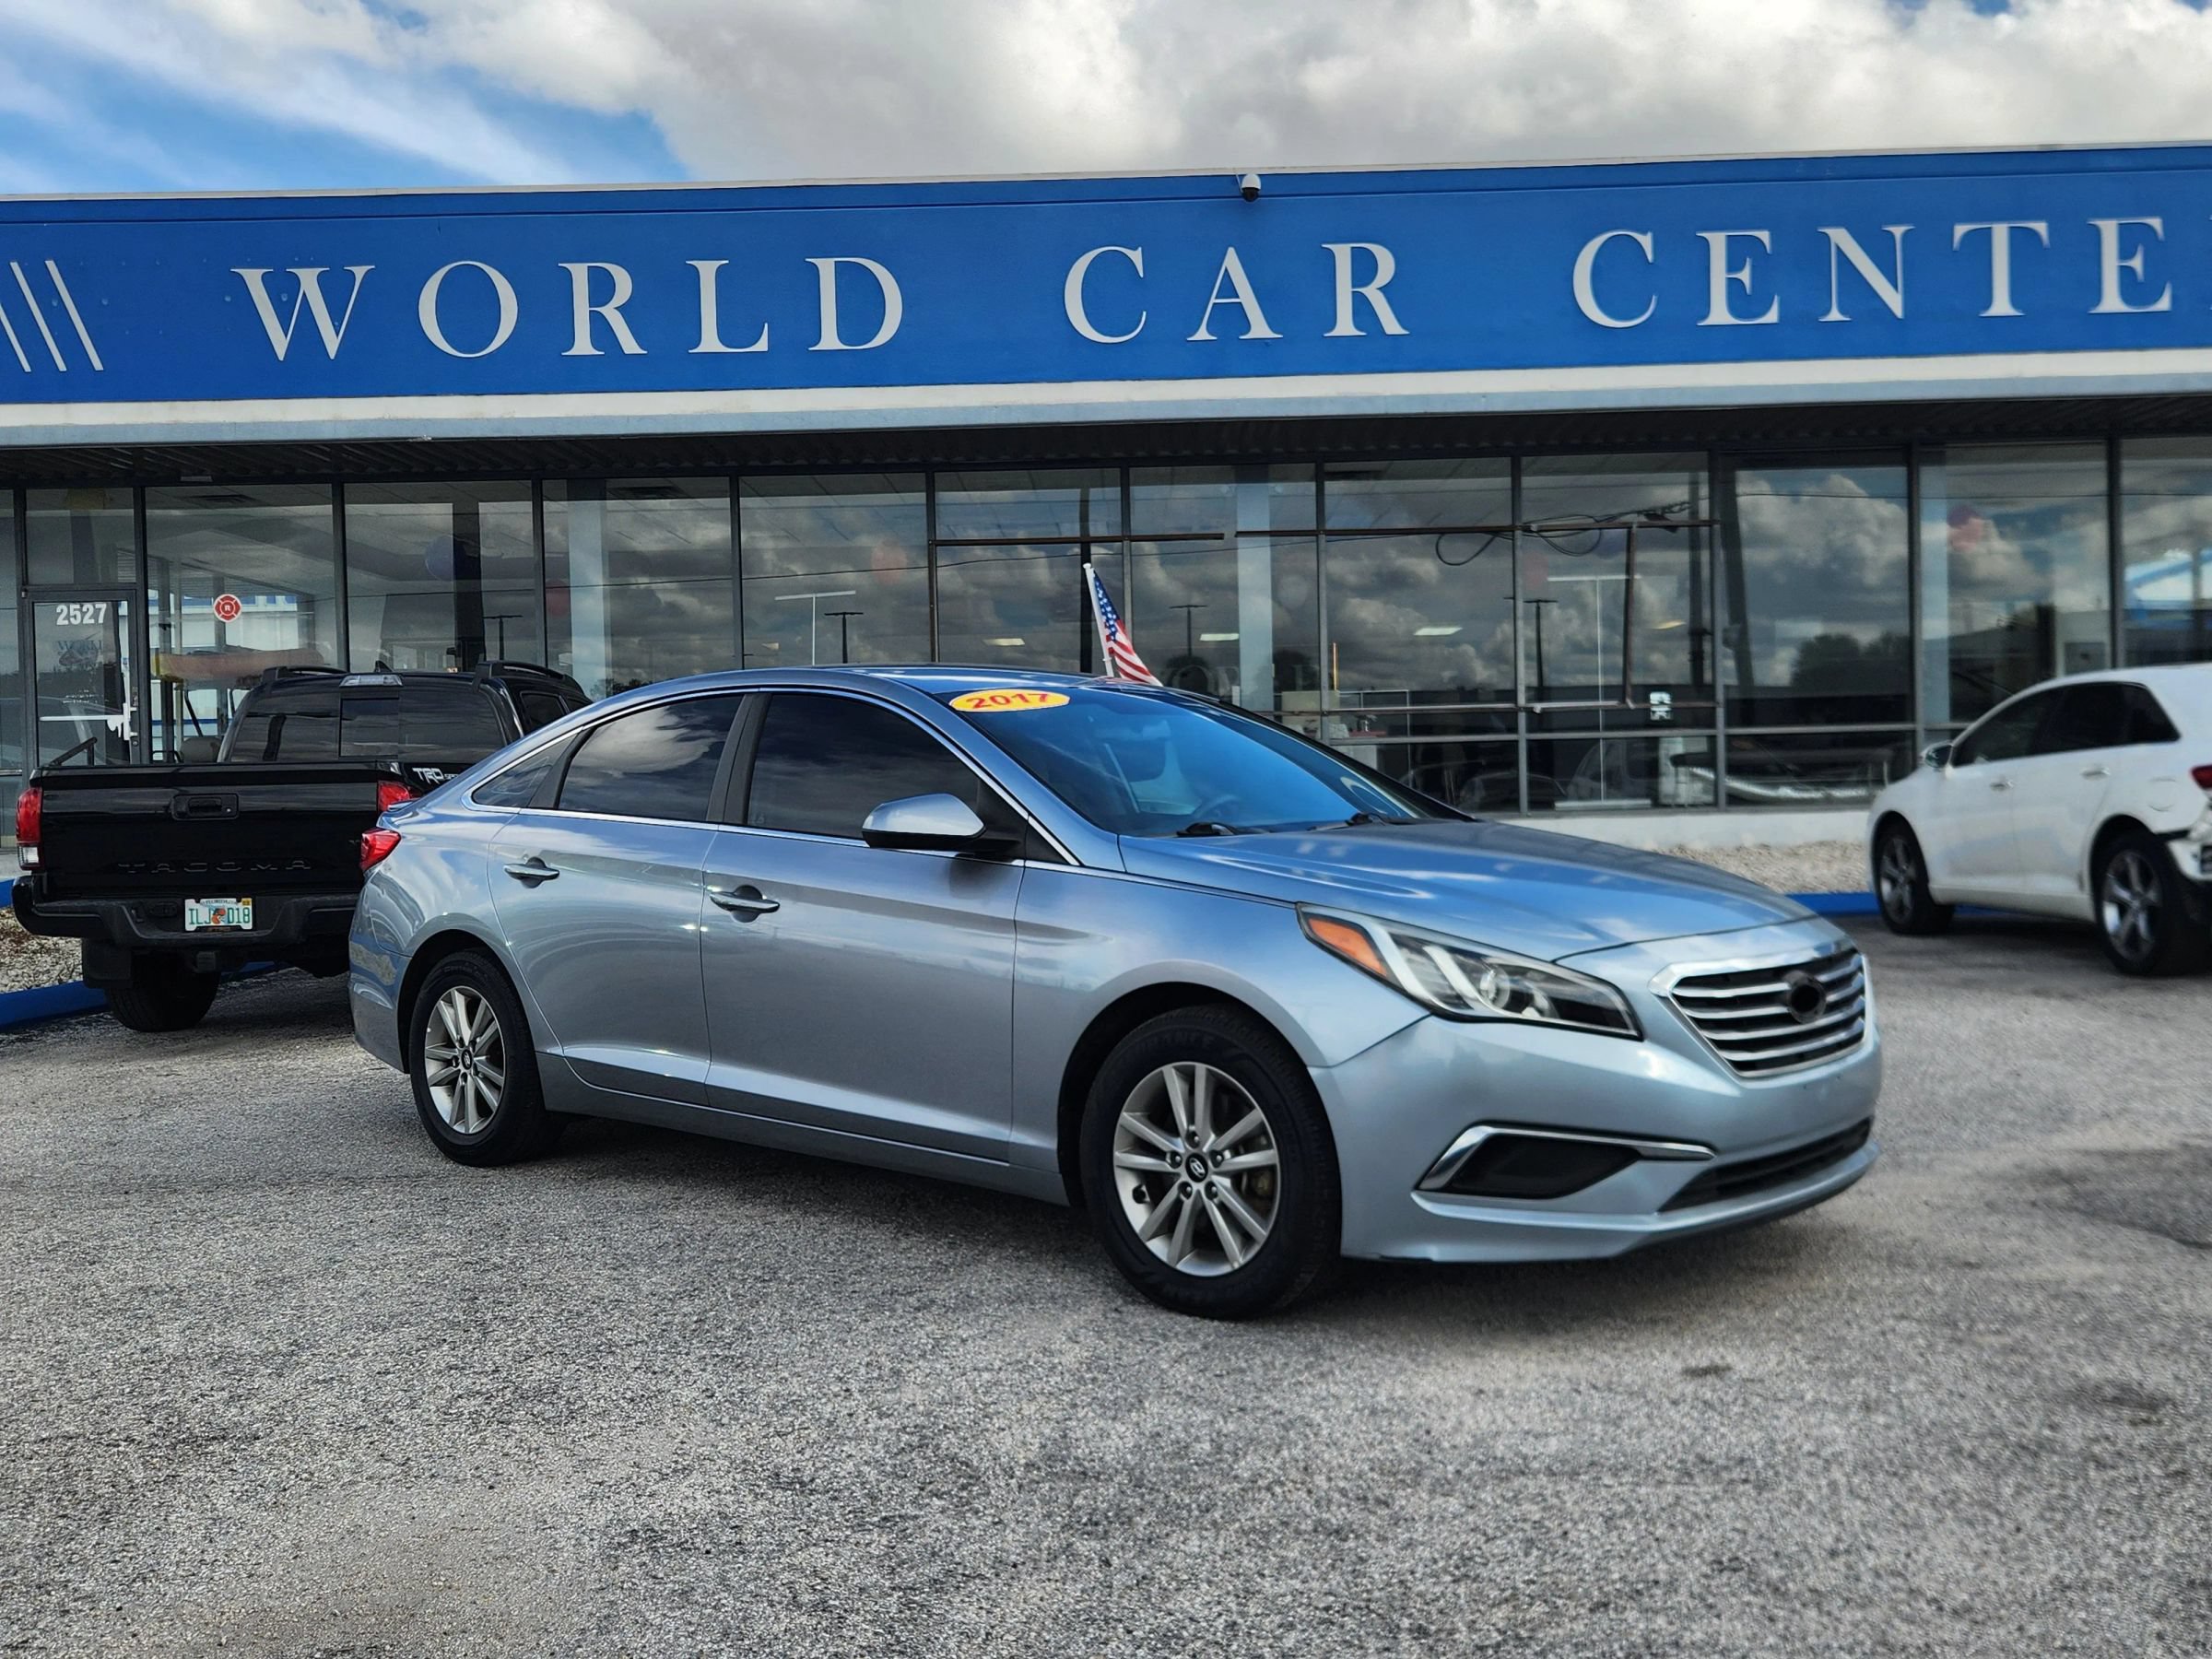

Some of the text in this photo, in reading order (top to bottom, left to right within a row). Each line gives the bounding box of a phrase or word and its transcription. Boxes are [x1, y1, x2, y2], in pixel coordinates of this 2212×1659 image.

[229, 216, 2212, 361] WORLD CAR CENTE
[56, 603, 107, 626] 2527
[966, 692, 1049, 710] 2017
[412, 767, 444, 784] TRD
[118, 860, 312, 873] TACOMA
